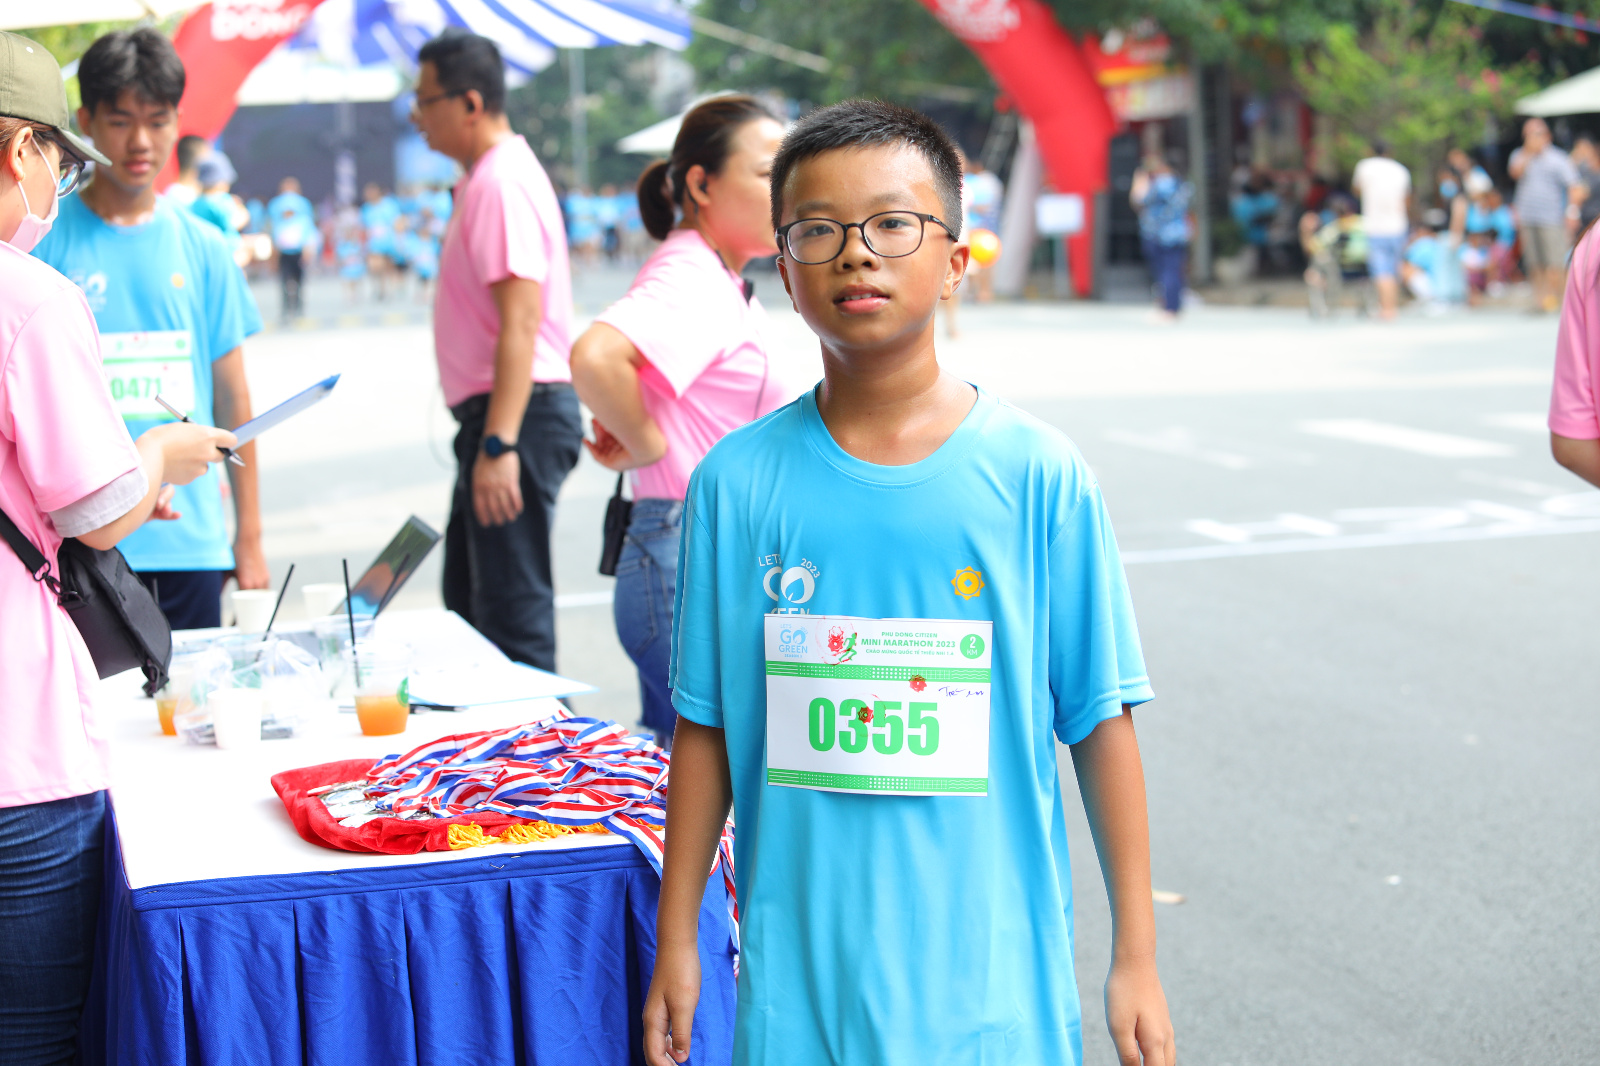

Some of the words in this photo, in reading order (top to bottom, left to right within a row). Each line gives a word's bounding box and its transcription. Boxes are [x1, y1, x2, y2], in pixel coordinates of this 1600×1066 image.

[110, 376, 162, 401] 0471
[800, 558, 821, 578] 2023
[780, 629, 806, 645] GO
[861, 638, 881, 646] MINI
[883, 638, 934, 648] MARATHON
[935, 640, 956, 648] 2023
[969, 636, 977, 649] 2
[778, 644, 808, 654] GREEN
[808, 697, 940, 756] 0355
